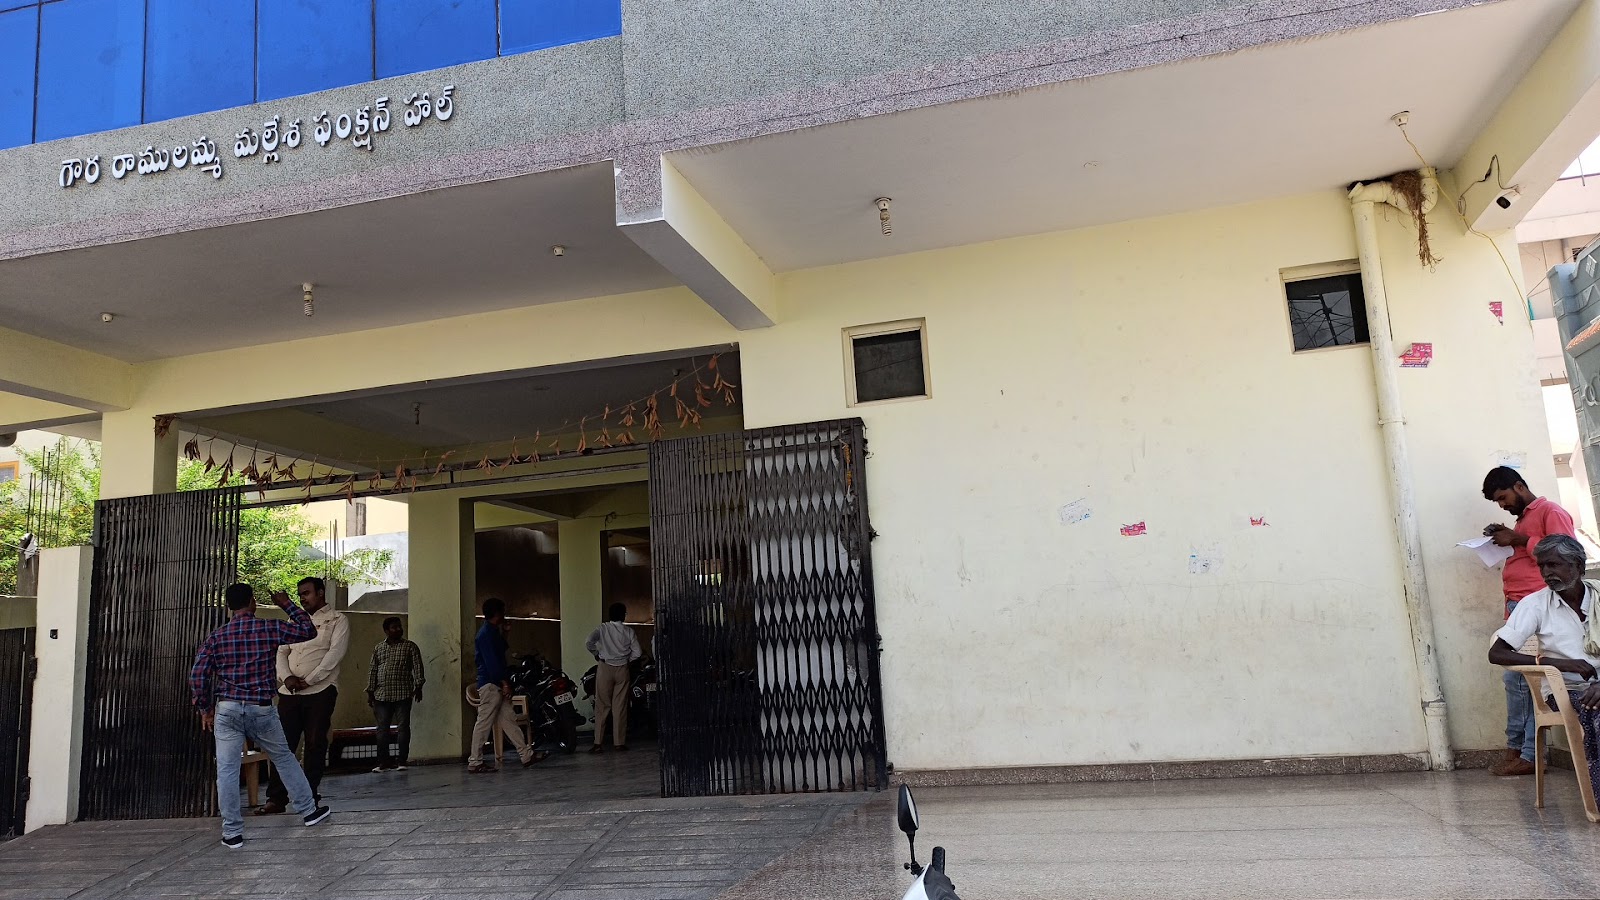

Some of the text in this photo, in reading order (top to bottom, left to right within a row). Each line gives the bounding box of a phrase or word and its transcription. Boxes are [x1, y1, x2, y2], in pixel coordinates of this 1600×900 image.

[59, 85, 455, 187] గౌర రాములమ్మ మల్లేశ ఫంక్షన్ హాల్
